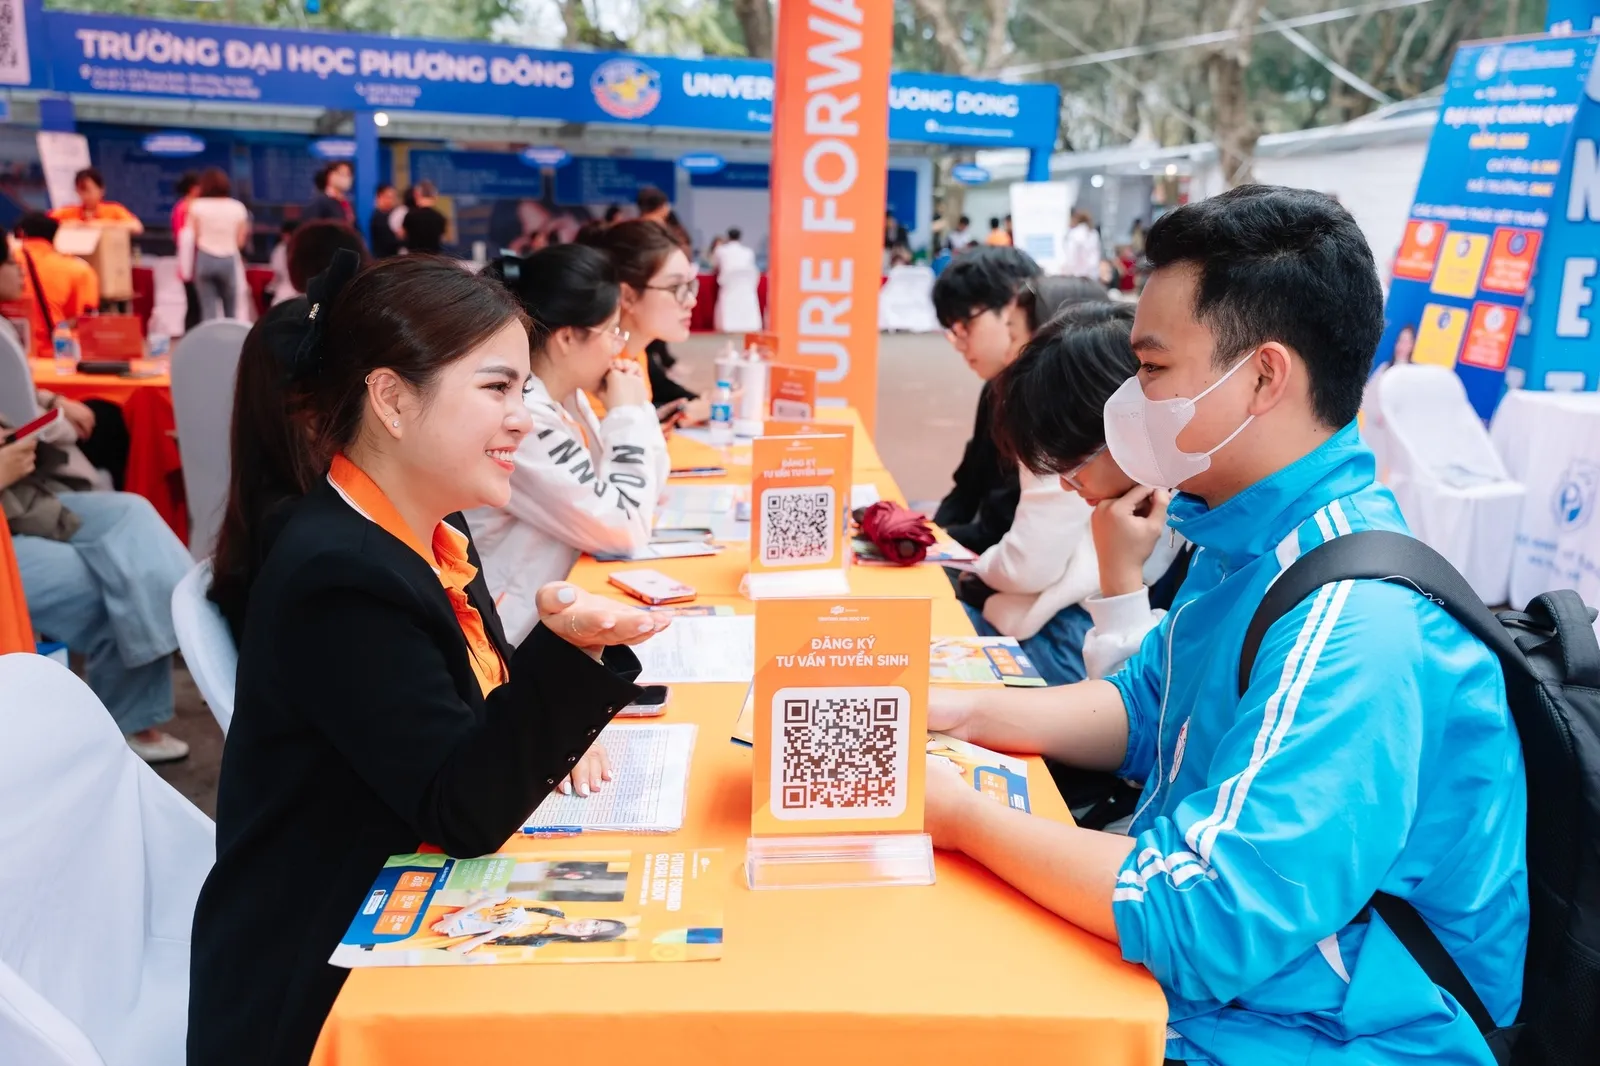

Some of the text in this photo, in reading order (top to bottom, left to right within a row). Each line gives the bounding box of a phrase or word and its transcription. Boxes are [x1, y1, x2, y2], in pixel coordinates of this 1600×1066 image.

[75, 28, 220, 67] TRƯỜNG
[224, 39, 282, 76] ĐẠI
[286, 43, 356, 80] HỌC
[489, 53, 574, 89] ĐÔNG
[955, 90, 1020, 118] DONG
[797, 257, 854, 409] URE
[811, 635, 876, 650] ĐĂNG KÝ
[776, 651, 909, 667] TƯ VẤN TUYỂN SINH
